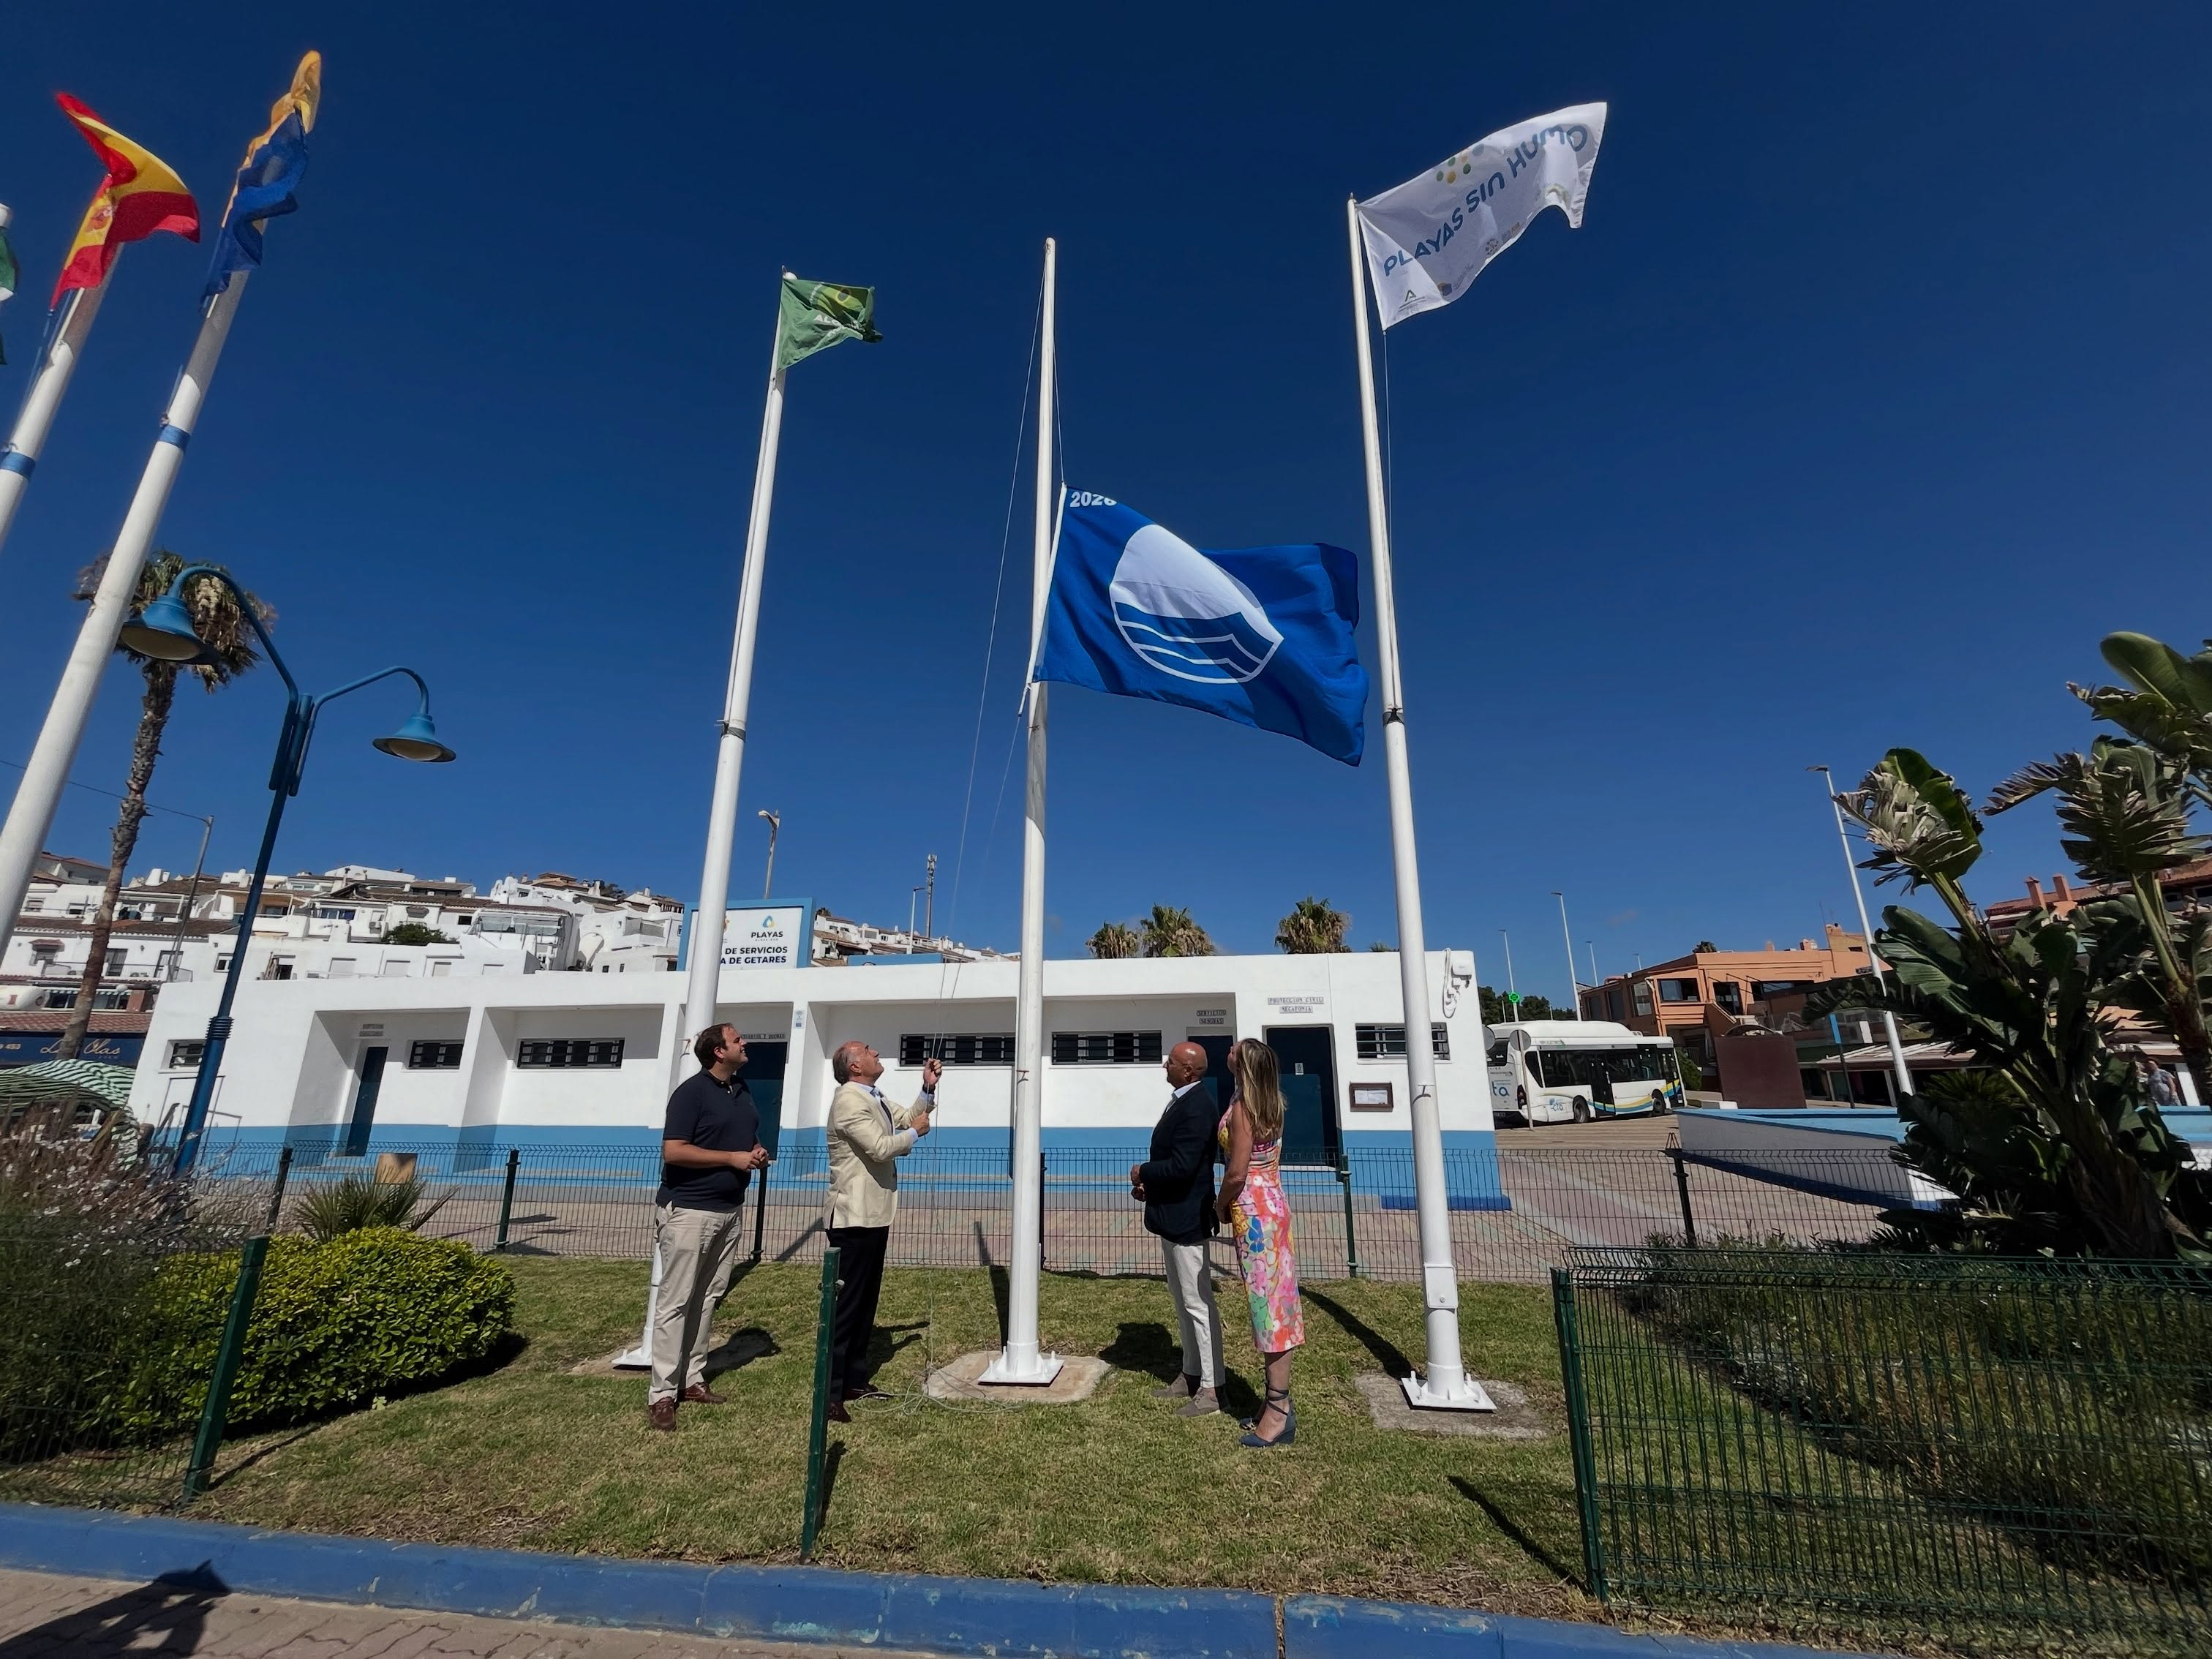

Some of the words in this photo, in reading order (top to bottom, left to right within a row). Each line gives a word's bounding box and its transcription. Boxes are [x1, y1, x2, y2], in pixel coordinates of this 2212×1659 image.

[1383, 207, 1464, 277] PLAYAS
[750, 930, 783, 938] PLAYAS
[740, 946, 788, 955] SERVICIOS
[744, 955, 786, 963] GETARES
[83, 1038, 121, 1055] Olas
